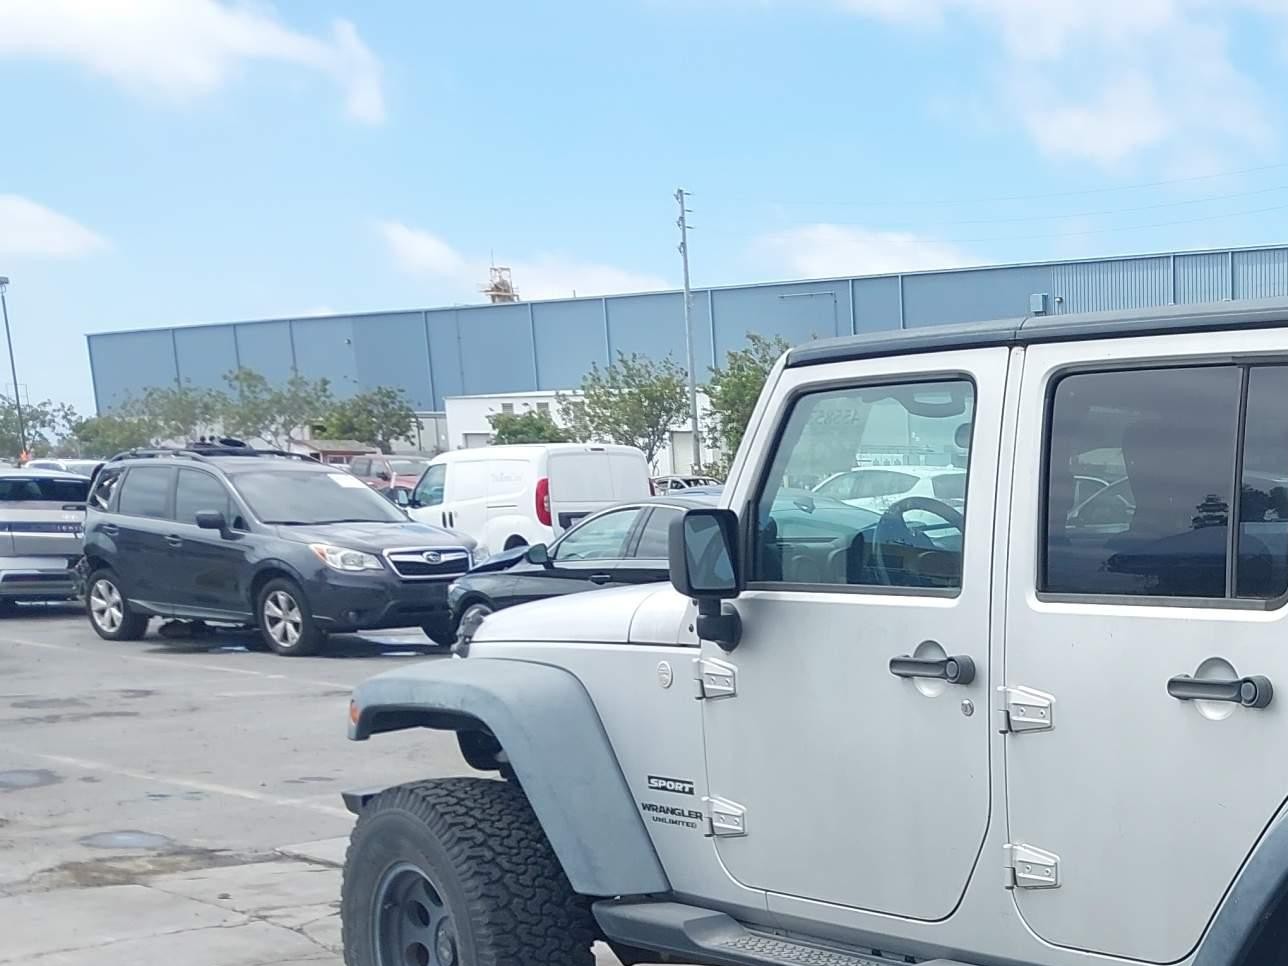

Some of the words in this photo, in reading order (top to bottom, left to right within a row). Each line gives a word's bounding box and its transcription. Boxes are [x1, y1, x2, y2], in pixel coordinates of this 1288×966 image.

[648, 778, 694, 792] SPORT
[641, 802, 703, 821] WRANGLER
[652, 815, 697, 828] UNLIMITED
